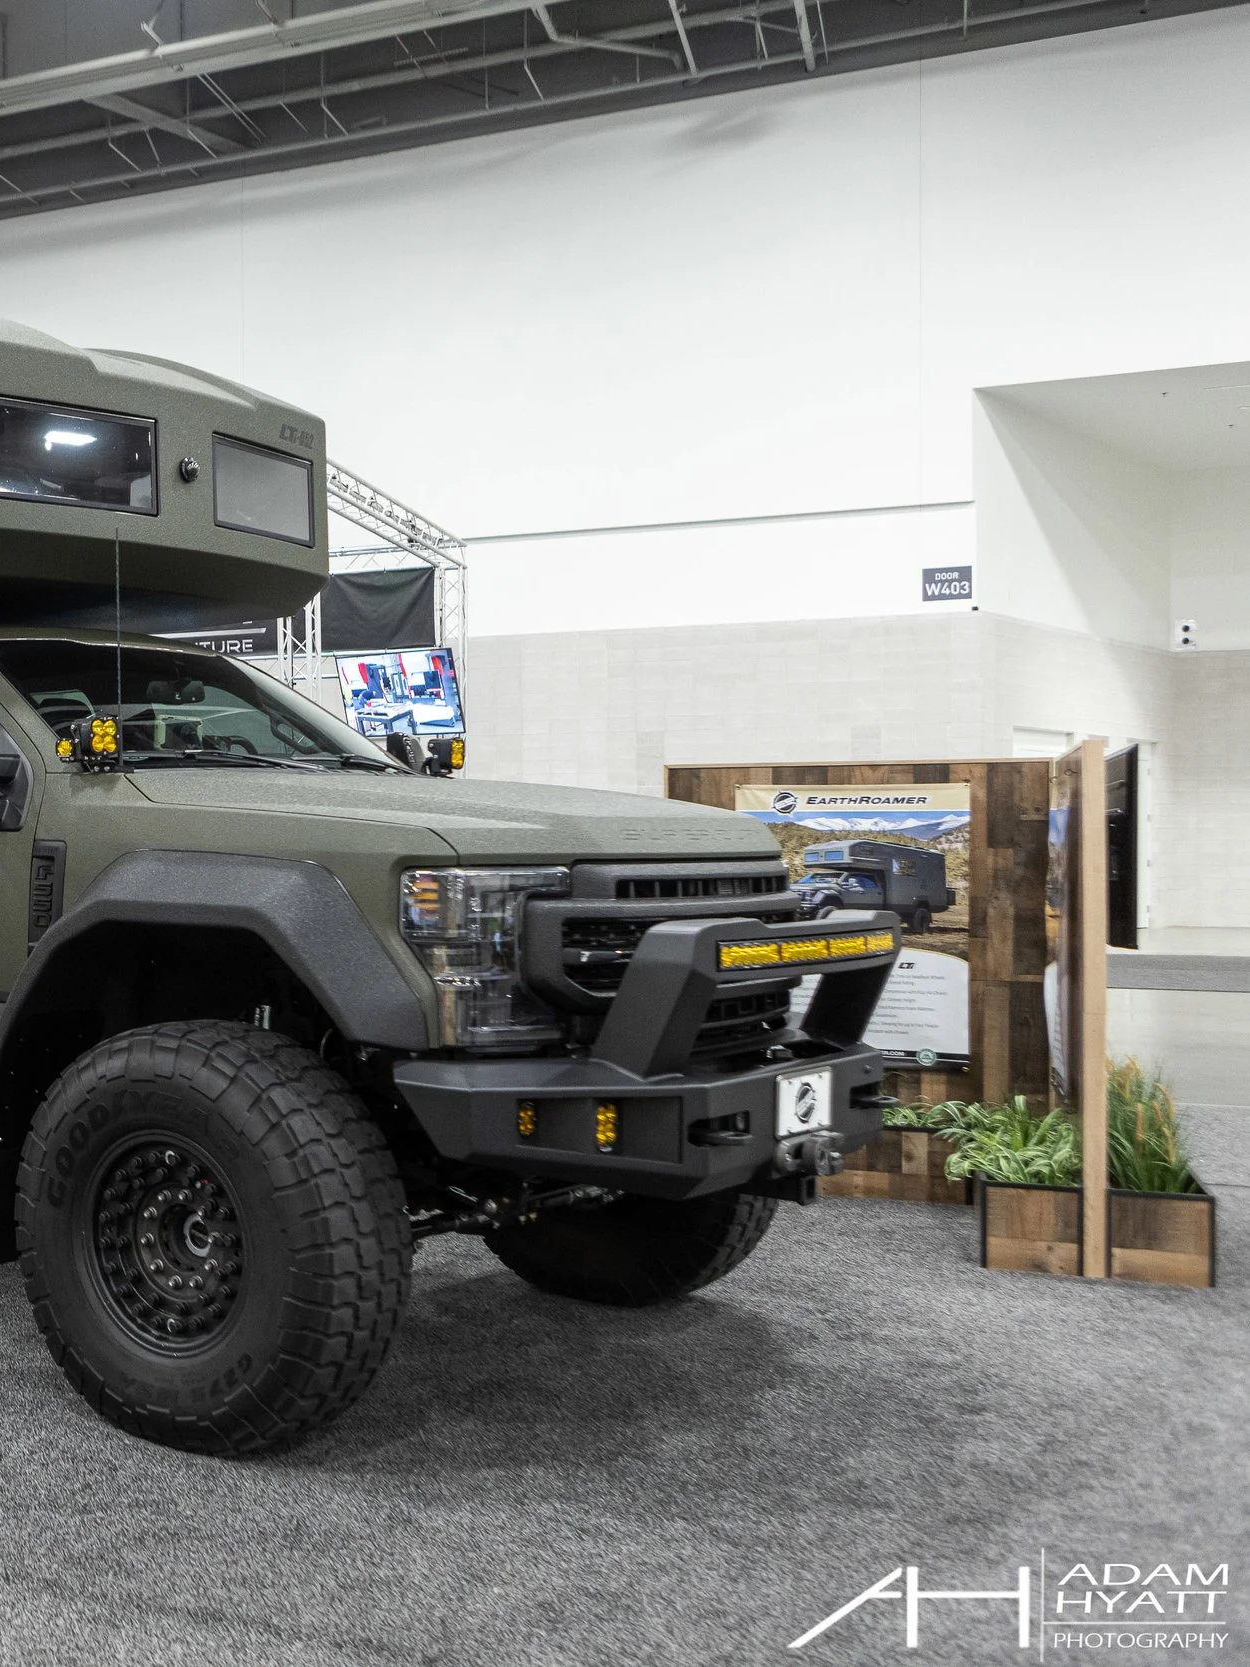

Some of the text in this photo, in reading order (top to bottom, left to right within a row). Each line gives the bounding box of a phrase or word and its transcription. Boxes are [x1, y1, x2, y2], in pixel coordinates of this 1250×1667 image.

[934, 571, 959, 581] DOOR
[925, 581, 970, 597] W403
[195, 639, 254, 653] TURE
[805, 796, 928, 805] EARTHROAMER
